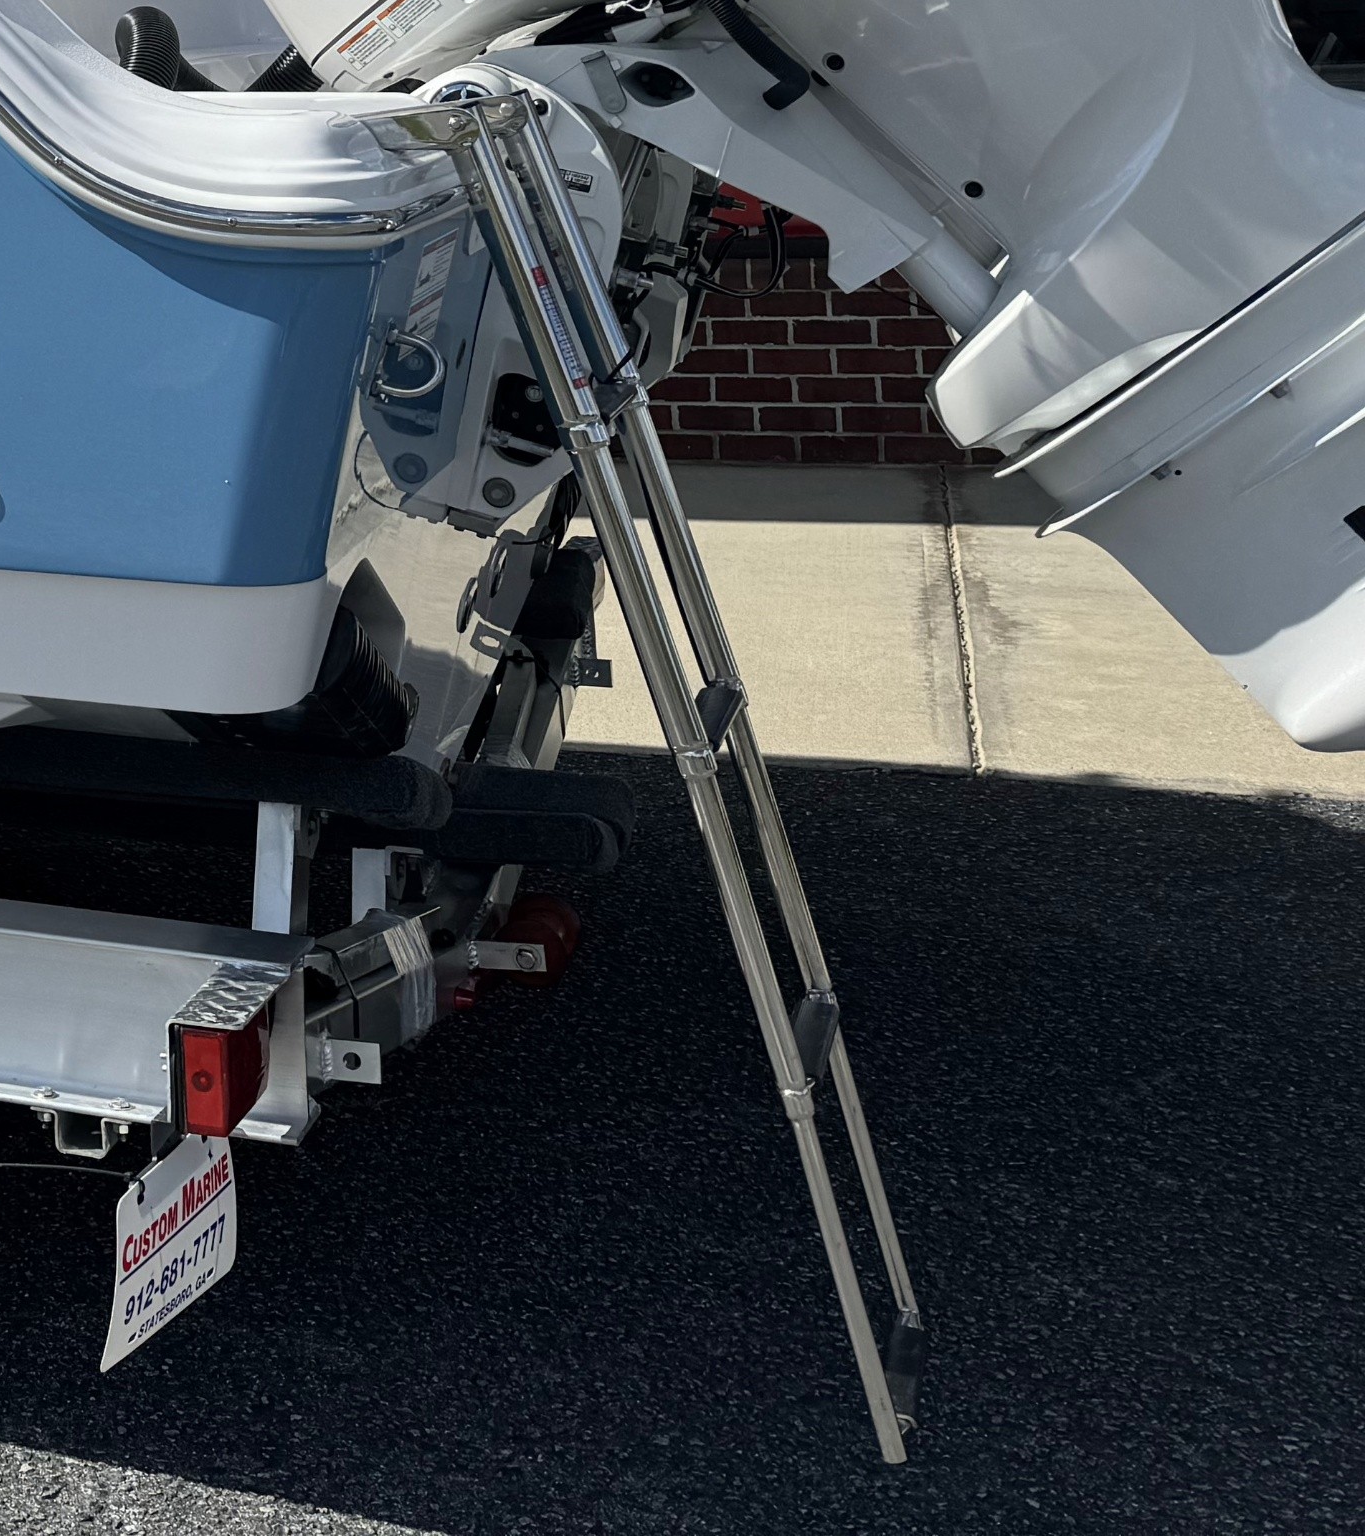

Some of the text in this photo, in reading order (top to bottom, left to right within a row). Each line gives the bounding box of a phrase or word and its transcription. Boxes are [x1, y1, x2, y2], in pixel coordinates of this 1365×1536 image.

[122, 1151, 231, 1274] CUSTOM MARINE
[123, 1213, 226, 1326] 912-681-7777
[137, 1271, 208, 1340] STATESBORO, GA
